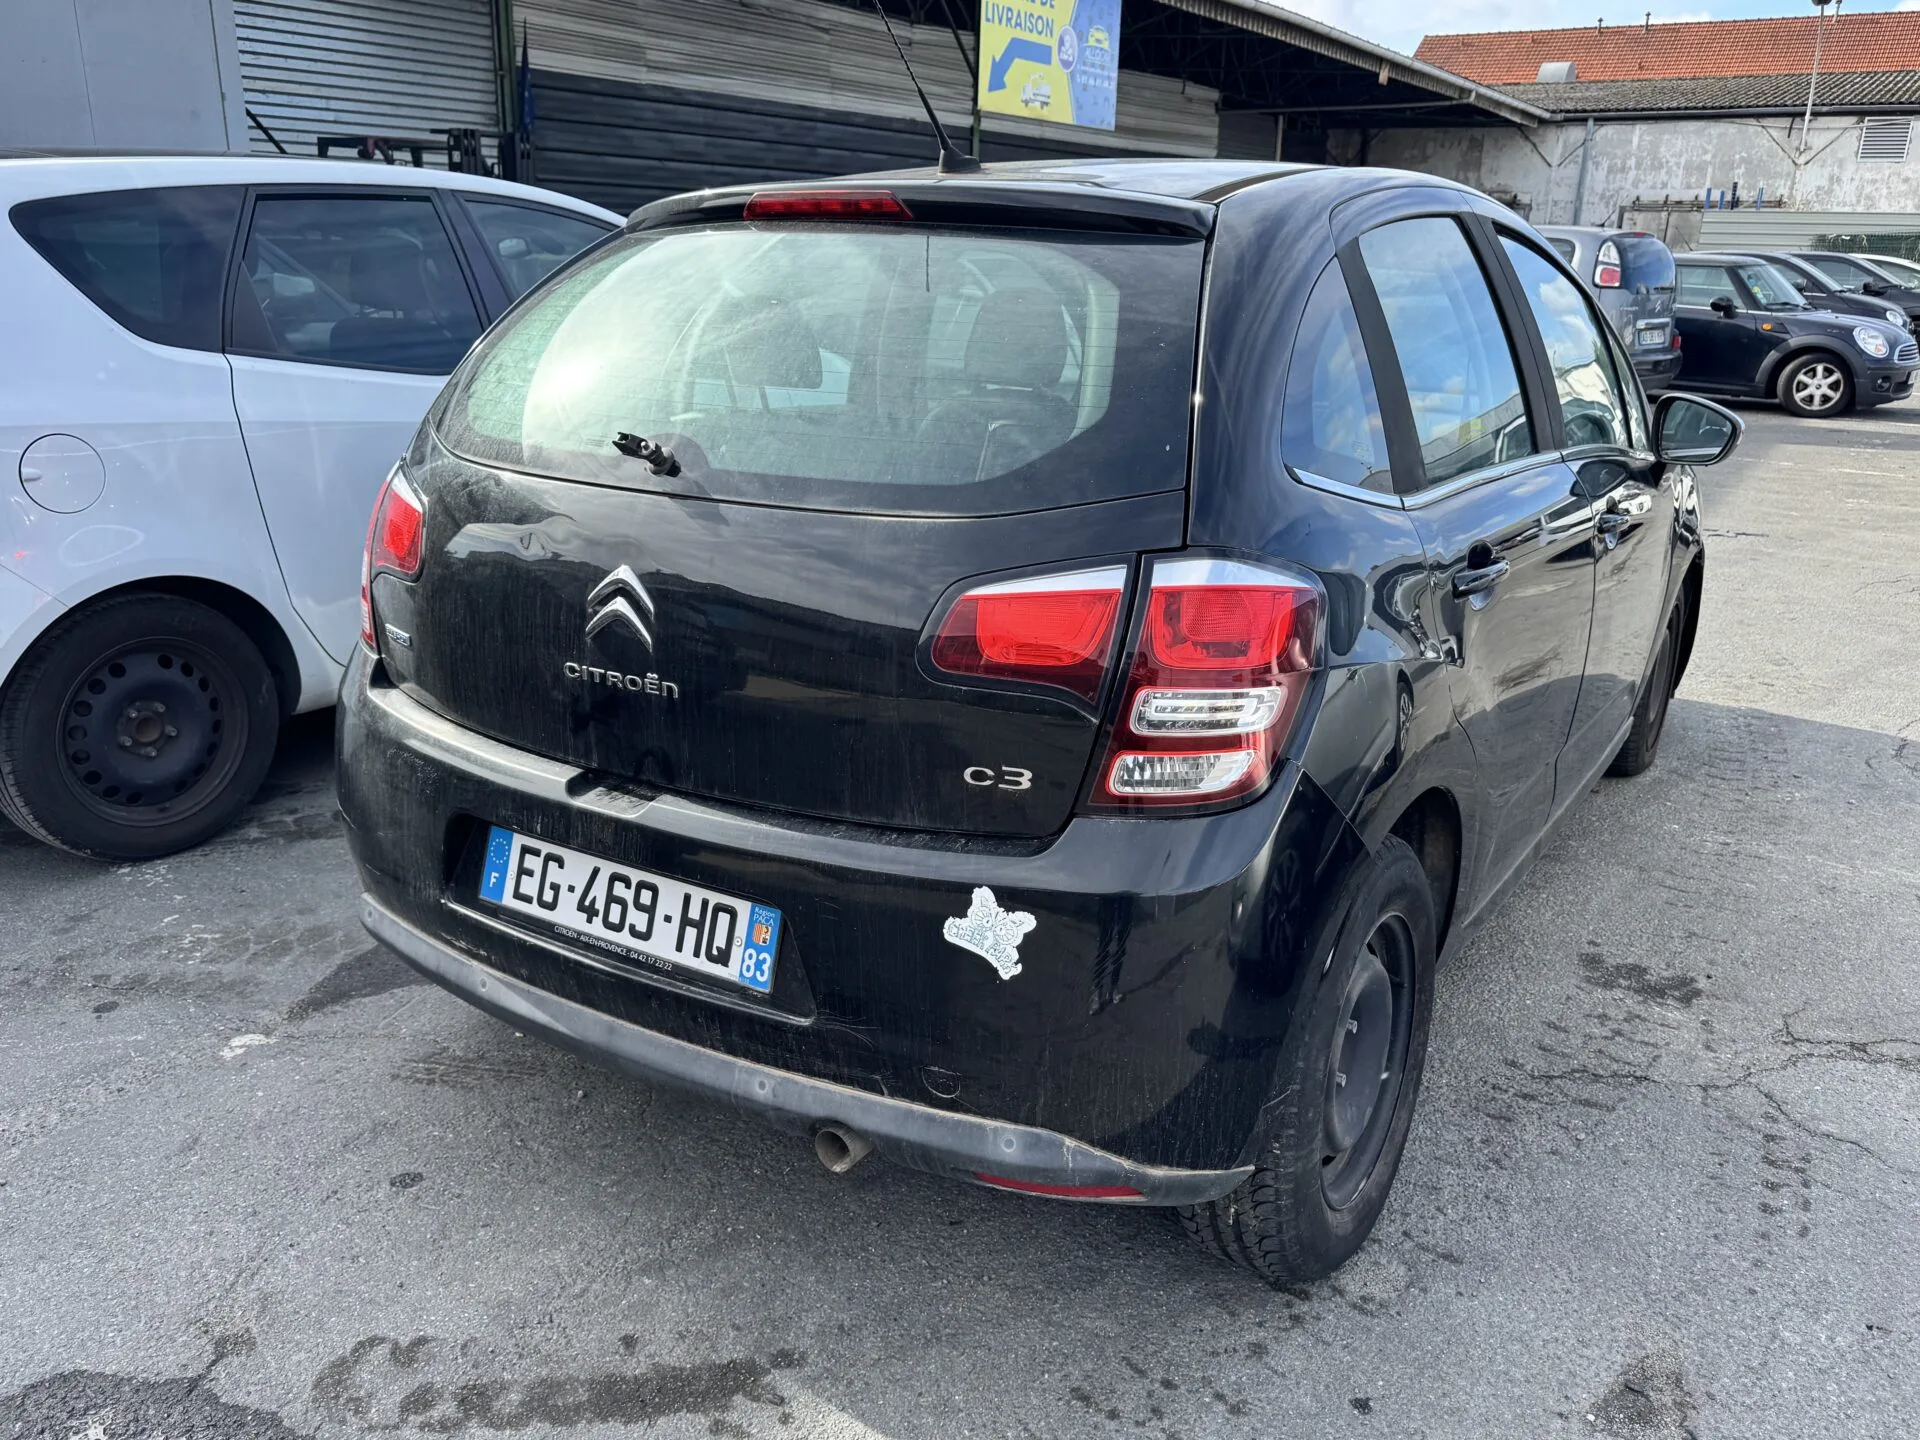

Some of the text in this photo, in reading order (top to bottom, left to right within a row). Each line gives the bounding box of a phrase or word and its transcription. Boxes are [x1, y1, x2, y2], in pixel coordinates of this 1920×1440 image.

[985, 1, 1054, 38] LIVRAISON
[963, 766, 1033, 790] C3
[489, 872, 499, 887] F
[512, 843, 739, 968] EG-469-HQ
[753, 913, 774, 926] PACA
[742, 948, 771, 982] 83
